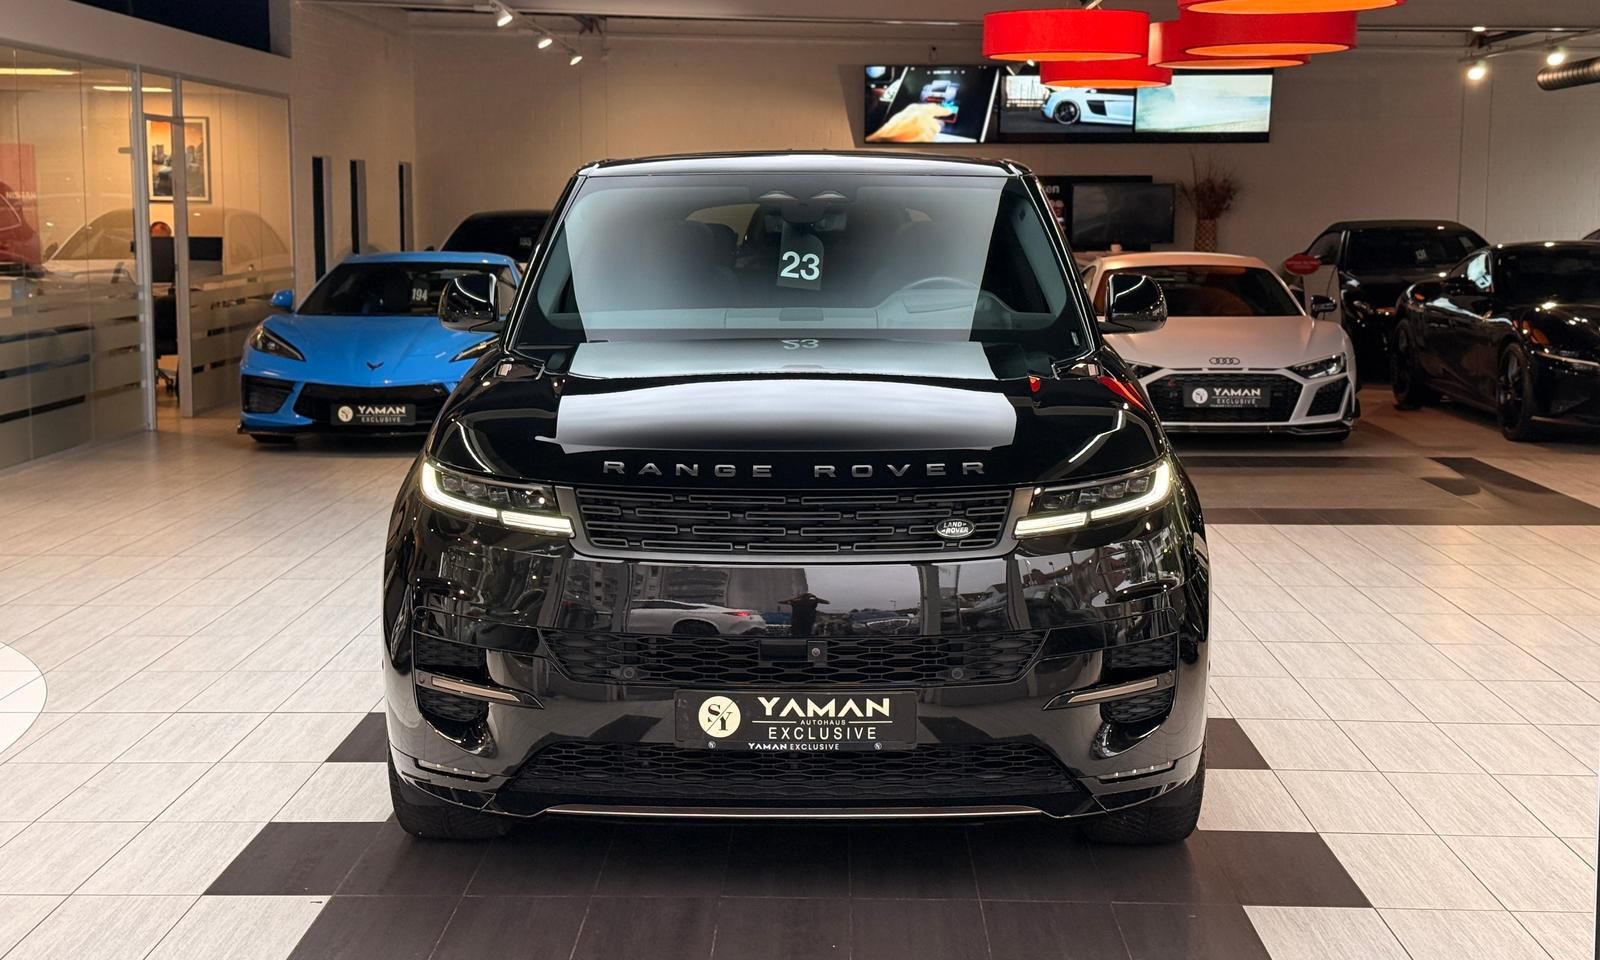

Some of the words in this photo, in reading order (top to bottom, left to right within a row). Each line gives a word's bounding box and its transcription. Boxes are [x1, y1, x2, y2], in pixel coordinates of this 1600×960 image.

[780, 251, 820, 280] 23
[412, 288, 428, 301] 194
[1213, 387, 1261, 396] YAMAN
[358, 405, 406, 415] YAMAN
[603, 461, 772, 478] RANGE
[814, 462, 984, 478] ROVER
[757, 696, 890, 718] YAMAN
[768, 727, 876, 740] EXCLUSIVE
[748, 742, 787, 750] YAMAN
[790, 743, 840, 751] EXCLUSIVE
